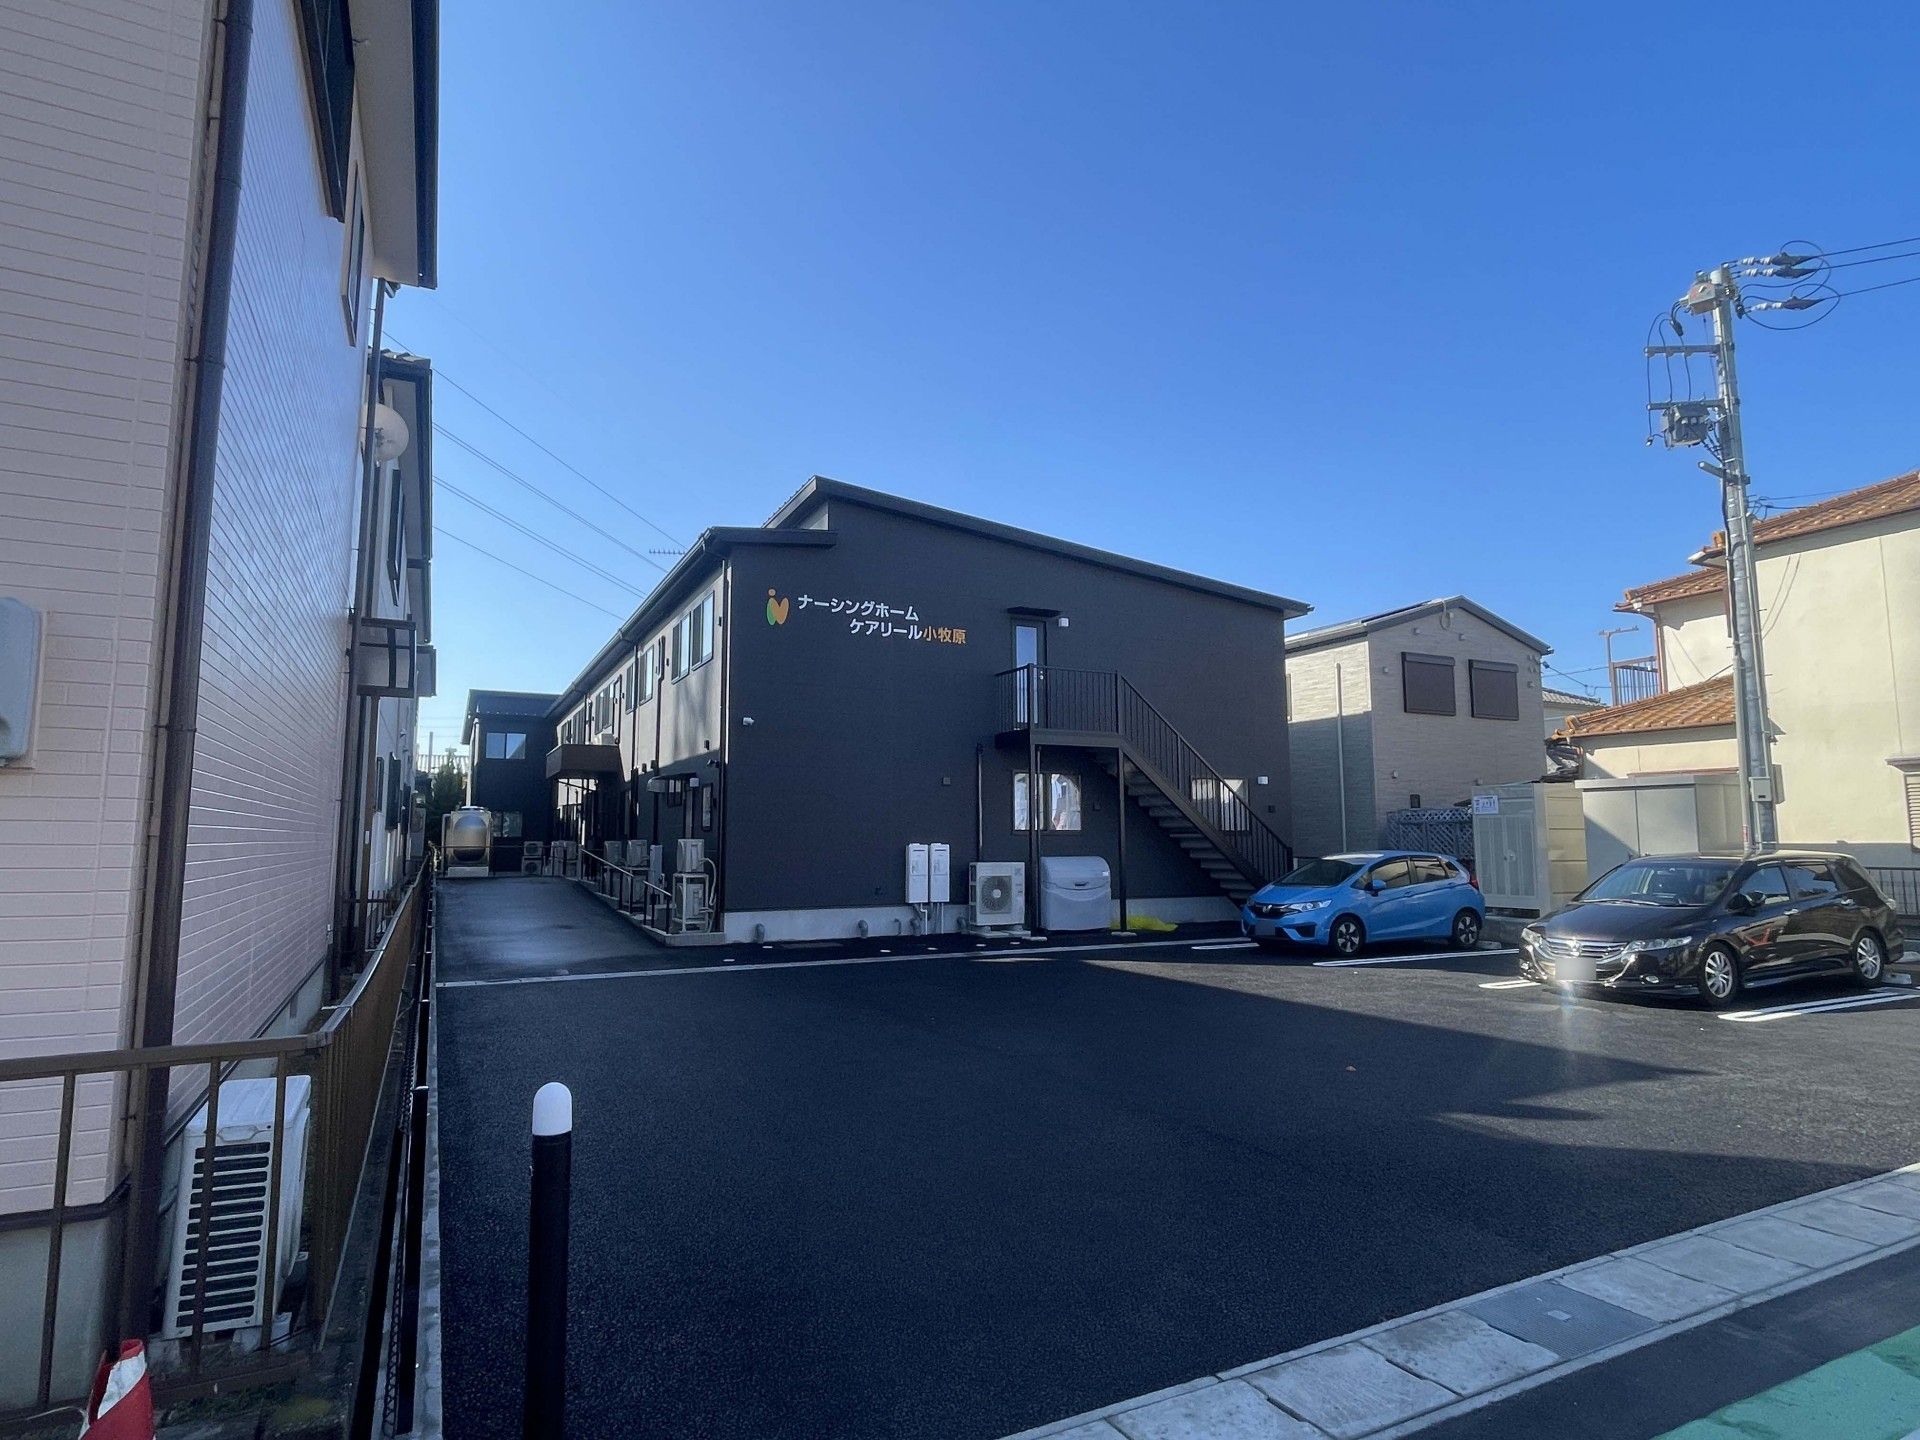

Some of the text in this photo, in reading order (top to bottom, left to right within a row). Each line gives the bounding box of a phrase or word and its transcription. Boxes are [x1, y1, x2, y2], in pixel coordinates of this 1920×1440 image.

[797, 594, 919, 621] ナーシングホーム
[849, 618, 966, 644] ケアリール小牧原
